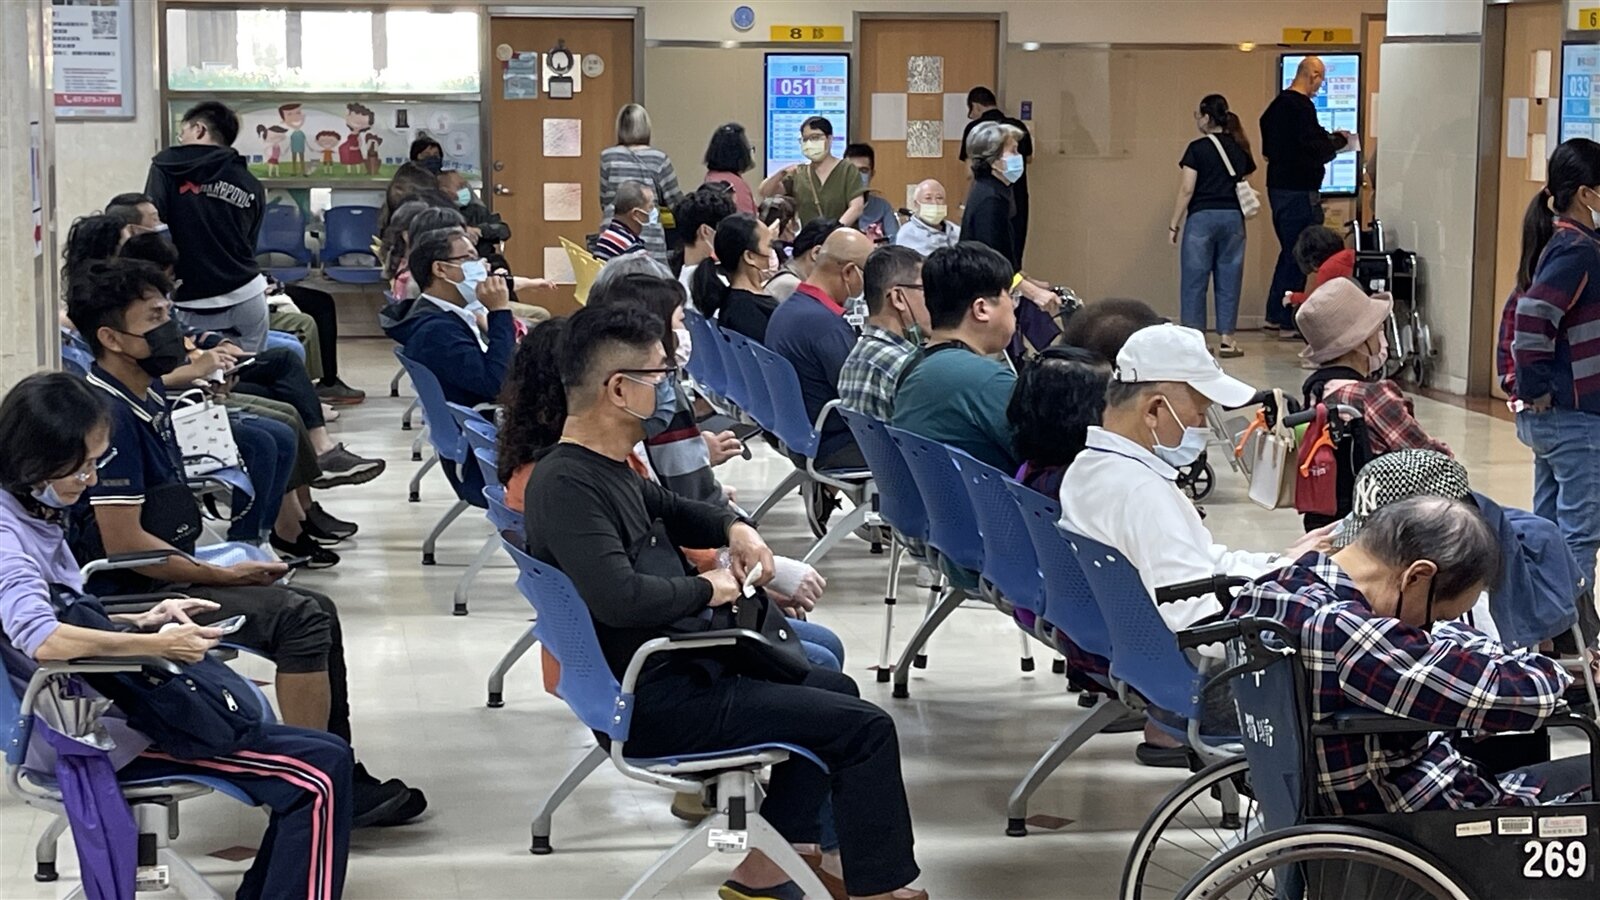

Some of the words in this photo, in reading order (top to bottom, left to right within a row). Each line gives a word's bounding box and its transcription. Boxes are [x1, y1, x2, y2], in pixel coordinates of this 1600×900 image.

[1590, 12, 1597, 27] 6
[790, 28, 802, 39] 8
[1301, 31, 1312, 41] 7
[781, 79, 812, 95] 051
[1570, 76, 1590, 97] 033
[1523, 840, 1587, 878] 269
